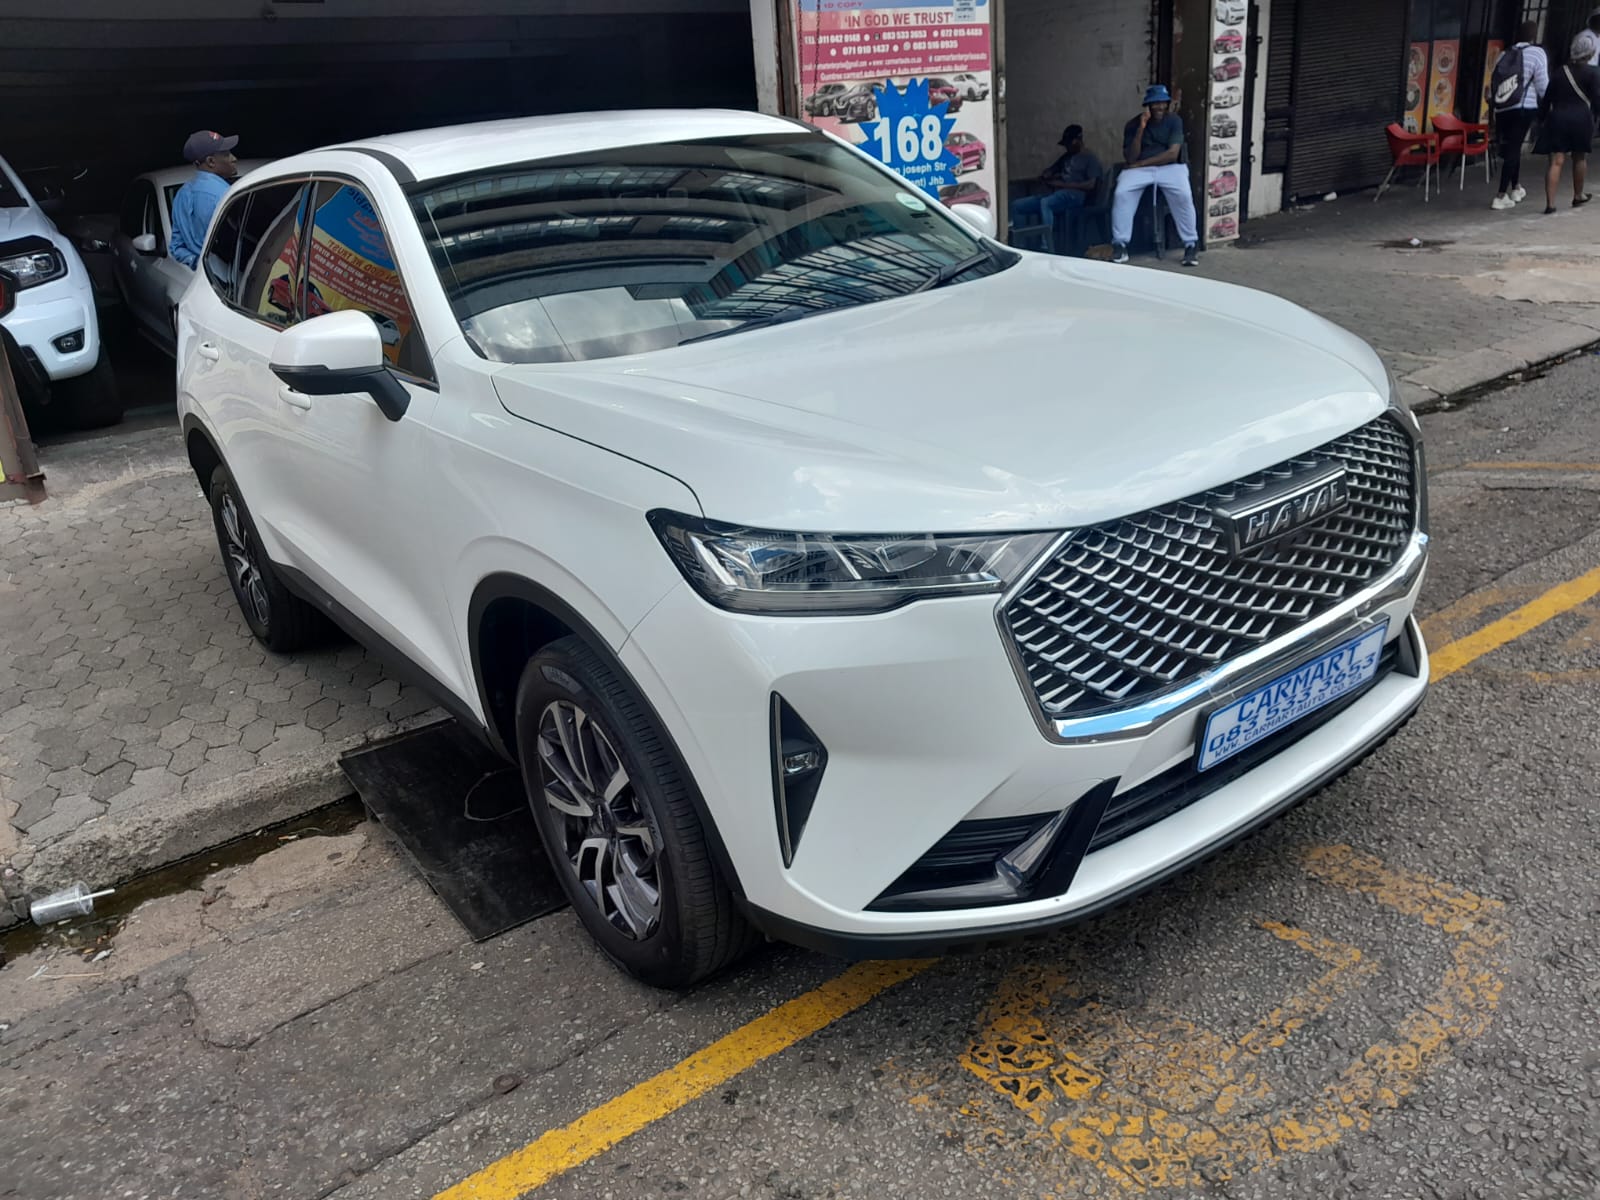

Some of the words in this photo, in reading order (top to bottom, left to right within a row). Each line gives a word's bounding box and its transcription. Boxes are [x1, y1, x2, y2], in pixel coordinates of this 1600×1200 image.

[837, 1, 864, 9] COPY
[864, 14, 889, 27] GOD
[893, 13, 911, 26] WE
[1497, 74, 1518, 96] NIKE
[874, 114, 943, 163] 168
[902, 163, 932, 176] joseph
[934, 161, 947, 172] Str
[928, 176, 945, 186] Jhb
[1245, 481, 1345, 544] HAVAL
[1237, 642, 1362, 723] CARMART
[1208, 716, 1258, 753] 083
[1265, 687, 1313, 721] 533
[1318, 652, 1376, 692] 3653
